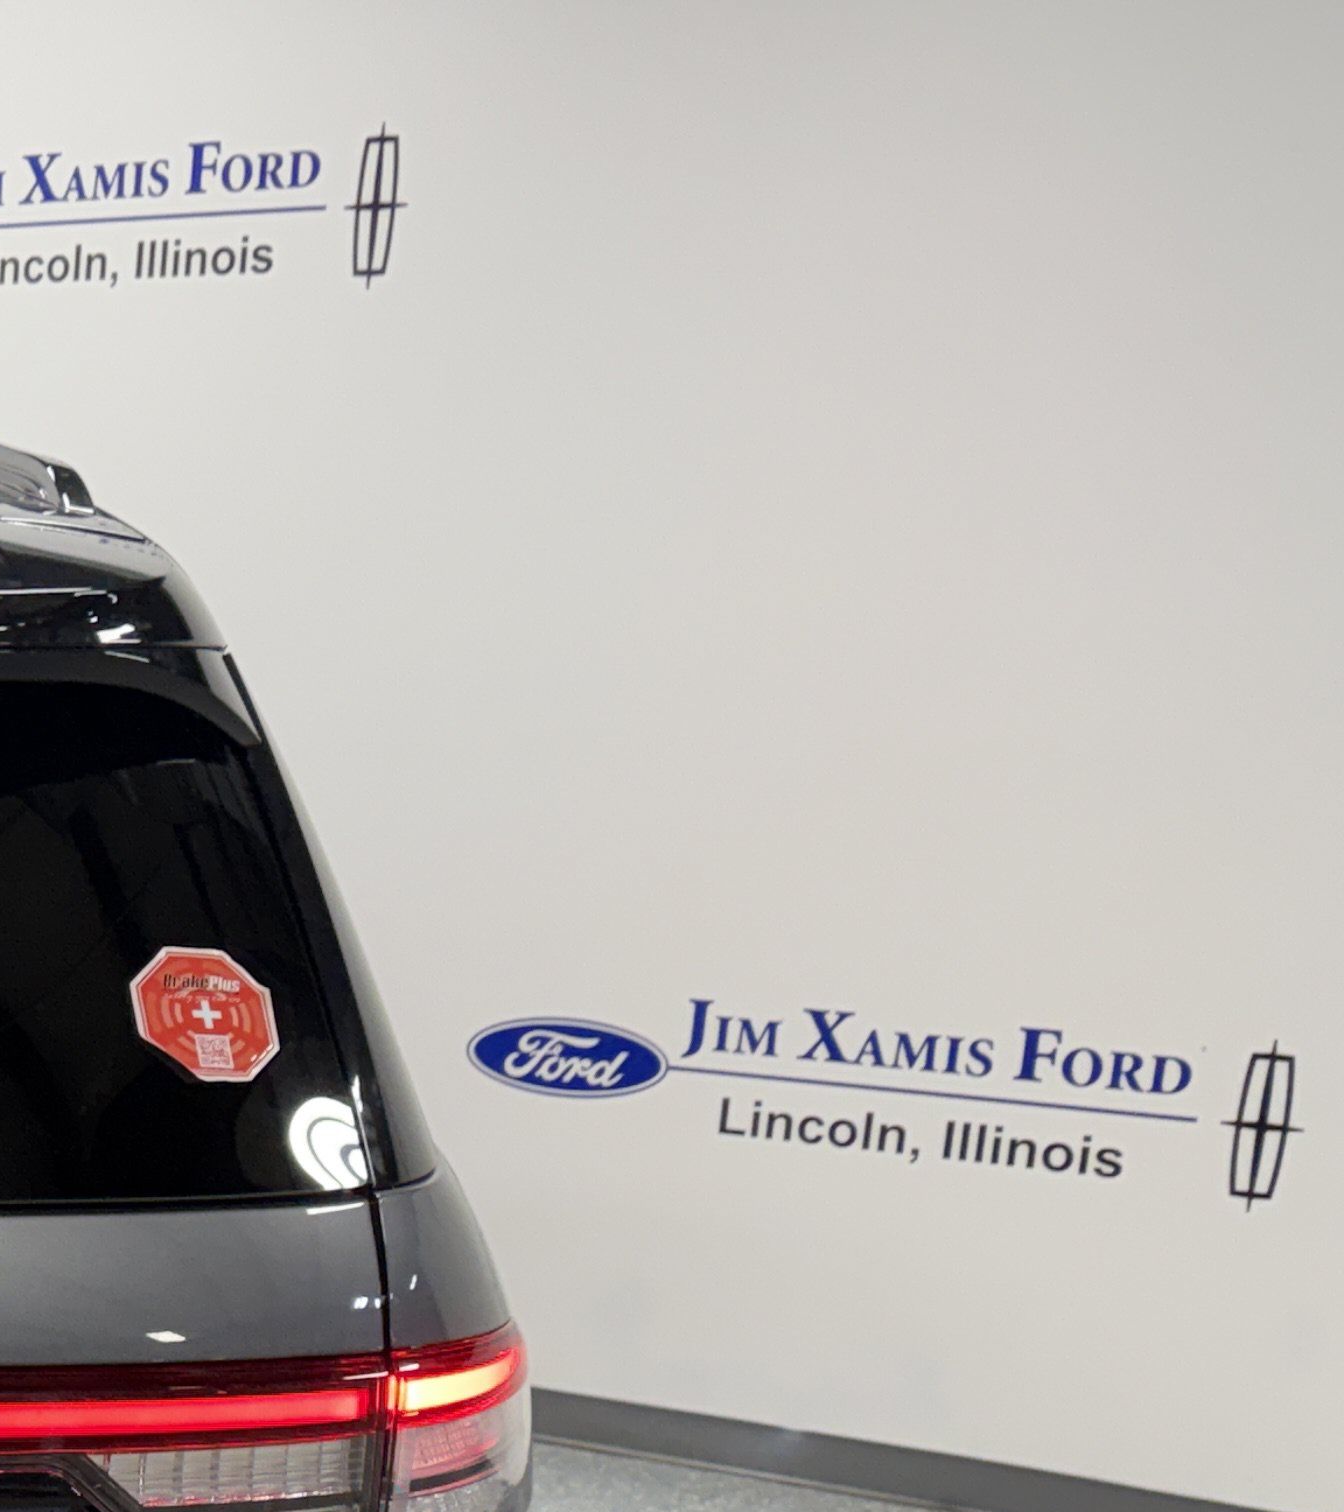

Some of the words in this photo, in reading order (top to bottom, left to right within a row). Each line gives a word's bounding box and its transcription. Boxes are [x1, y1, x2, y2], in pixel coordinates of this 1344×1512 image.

[18, 152, 170, 205] XAMIS
[184, 140, 322, 195] FORD
[134, 235, 275, 279] Illinois
[502, 1027, 628, 1089] Ford
[681, 998, 782, 1060] JIM
[795, 1007, 996, 1079] XAMIS
[1012, 1025, 1194, 1096] FORD
[716, 1096, 922, 1165] Lincoln,
[941, 1118, 1126, 1179] Illinois
